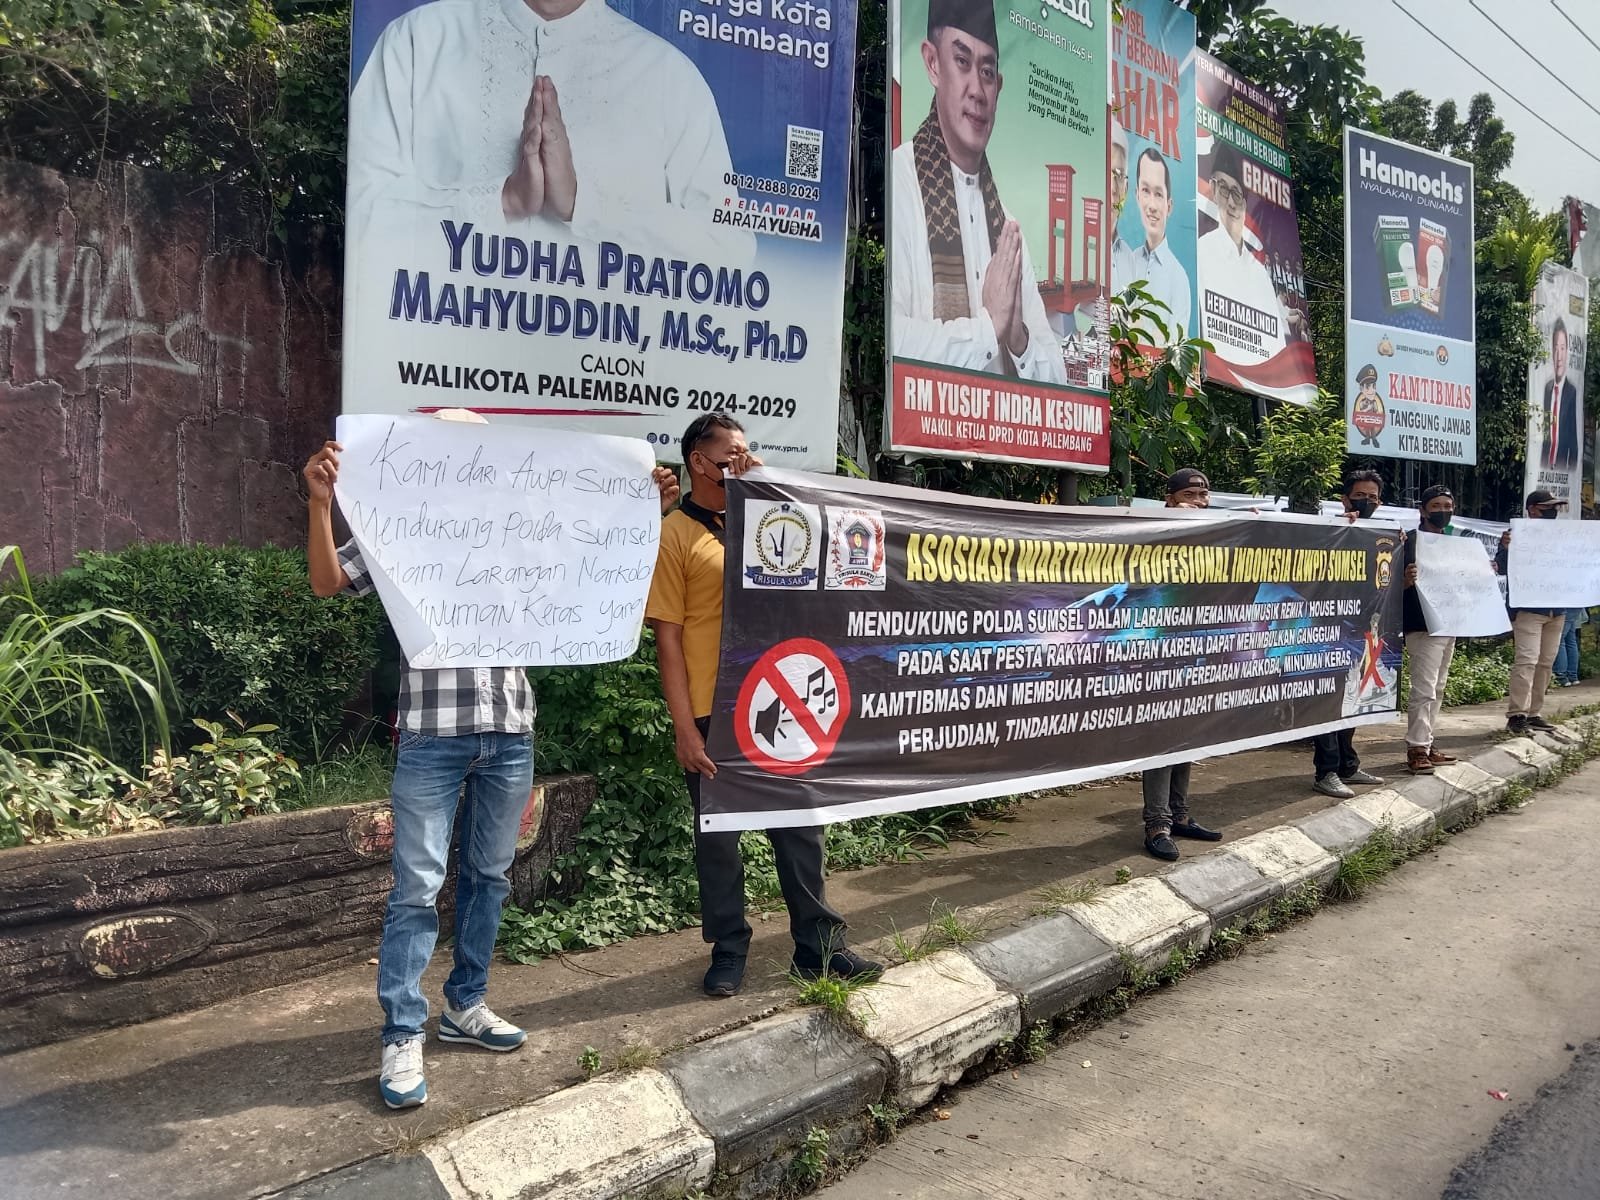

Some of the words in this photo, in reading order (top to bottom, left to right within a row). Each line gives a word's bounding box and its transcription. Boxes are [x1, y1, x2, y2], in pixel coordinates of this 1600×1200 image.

[678, 9, 830, 69] Palembang
[1009, 10, 1067, 51] RAMADAHAN
[1088, 52, 1094, 64] H
[1028, 88, 1067, 113] Menyambut
[1070, 107, 1088, 123] Bulan
[1028, 102, 1045, 118] yang
[1047, 109, 1066, 126] Penuh
[1197, 106, 1233, 142] SEKOLAH
[1235, 129, 1252, 153] DAN
[1253, 139, 1286, 171] BEROBAT
[723, 173, 754, 189] 0812
[758, 179, 787, 194] 2888
[791, 185, 820, 200] 2024
[1243, 160, 1291, 209] GRATIS
[1359, 147, 1464, 205] Hannochs
[1360, 180, 1413, 202] NYALAKAN
[713, 209, 821, 239] BARATAYUDHA
[724, 198, 814, 220] RELAWAN
[1206, 292, 1229, 317] HERI
[1230, 301, 1276, 336] AMALINDO
[1206, 316, 1228, 335] CALON
[1228, 324, 1262, 346] GUBERNUR
[745, 320, 808, 362] Ph.D
[581, 354, 645, 378] CALON
[398, 361, 530, 396] WALIKOTA
[538, 374, 680, 408] PALEMBANG
[687, 389, 798, 419] 2024-2029
[904, 376, 933, 412] RM
[936, 381, 990, 420] YUSUF
[994, 391, 1042, 427] INDRA
[1046, 399, 1104, 435] KESUMA
[1388, 372, 1472, 410] KAMTIBMAS
[921, 416, 953, 437] WAKIL
[956, 420, 985, 441] KETUA
[989, 424, 1014, 444] DPRD
[1017, 428, 1039, 447] KOTA
[1042, 432, 1092, 452] PALEMBANG
[1389, 409, 1440, 431] TANGGUNG
[1442, 417, 1471, 435] JAWAB
[761, 443, 808, 453] www.ypm.id
[1399, 434, 1420, 453] KITA
[1422, 437, 1463, 458] BERSAMA
[349, 501, 493, 549] Mendukung
[375, 549, 443, 586] alam
[906, 533, 1015, 583] ASOSIASI
[1016, 539, 1129, 584] WARTAWAN
[1128, 544, 1230, 584] PROFESIONAL
[1231, 547, 1291, 583] INDONESIA
[1291, 549, 1328, 582] (AWPI)
[1327, 550, 1368, 582] SUMSEL
[755, 573, 786, 585] TRISULA
[788, 575, 810, 585] SAKTI
[847, 610, 968, 637] MENDUKUNG
[973, 610, 1024, 634] POLDA
[1028, 608, 1083, 633] SUMSEL
[1088, 607, 1132, 630] DALAM
[1134, 606, 1194, 629] LARANGAN
[1194, 604, 1252, 625] MEMAINKAN
[1252, 603, 1280, 622] MUSIK
[1281, 601, 1303, 620] REMIX
[1309, 600, 1335, 617] HOUSE
[1336, 599, 1361, 616] MUSIC
[898, 651, 944, 676] PADA
[949, 647, 992, 673] SAAT
[996, 645, 1042, 670] PESTA
[1105, 639, 1159, 663] HAJATAN
[1161, 636, 1204, 659] KARENA
[1206, 634, 1235, 654] DAPAT
[1236, 629, 1296, 651] MENIMBULKAN
[1297, 625, 1341, 644] GANGGUAN
[860, 688, 970, 719] KAMTIBMAS
[974, 684, 1007, 709] DAN
[1011, 677, 1082, 706] MEMBUKA
[1085, 672, 1143, 698] PELUANG
[1145, 668, 1184, 692] UNTUK
[1185, 661, 1239, 687] PEREDARAN
[1240, 657, 1282, 678] NARKOBA,
[1283, 653, 1324, 673] MINUMAN
[899, 720, 1000, 755] PERJUDIAN,
[1005, 711, 1079, 742] TINDAKAN
[1079, 705, 1132, 732] ASUSILA
[1135, 698, 1182, 724] BAHKAN
[1182, 693, 1214, 717] DAPAT
[1214, 683, 1279, 712] MENIMBULKAN
[1280, 679, 1315, 700] KORBAN
[1316, 677, 1336, 695] JIWA
